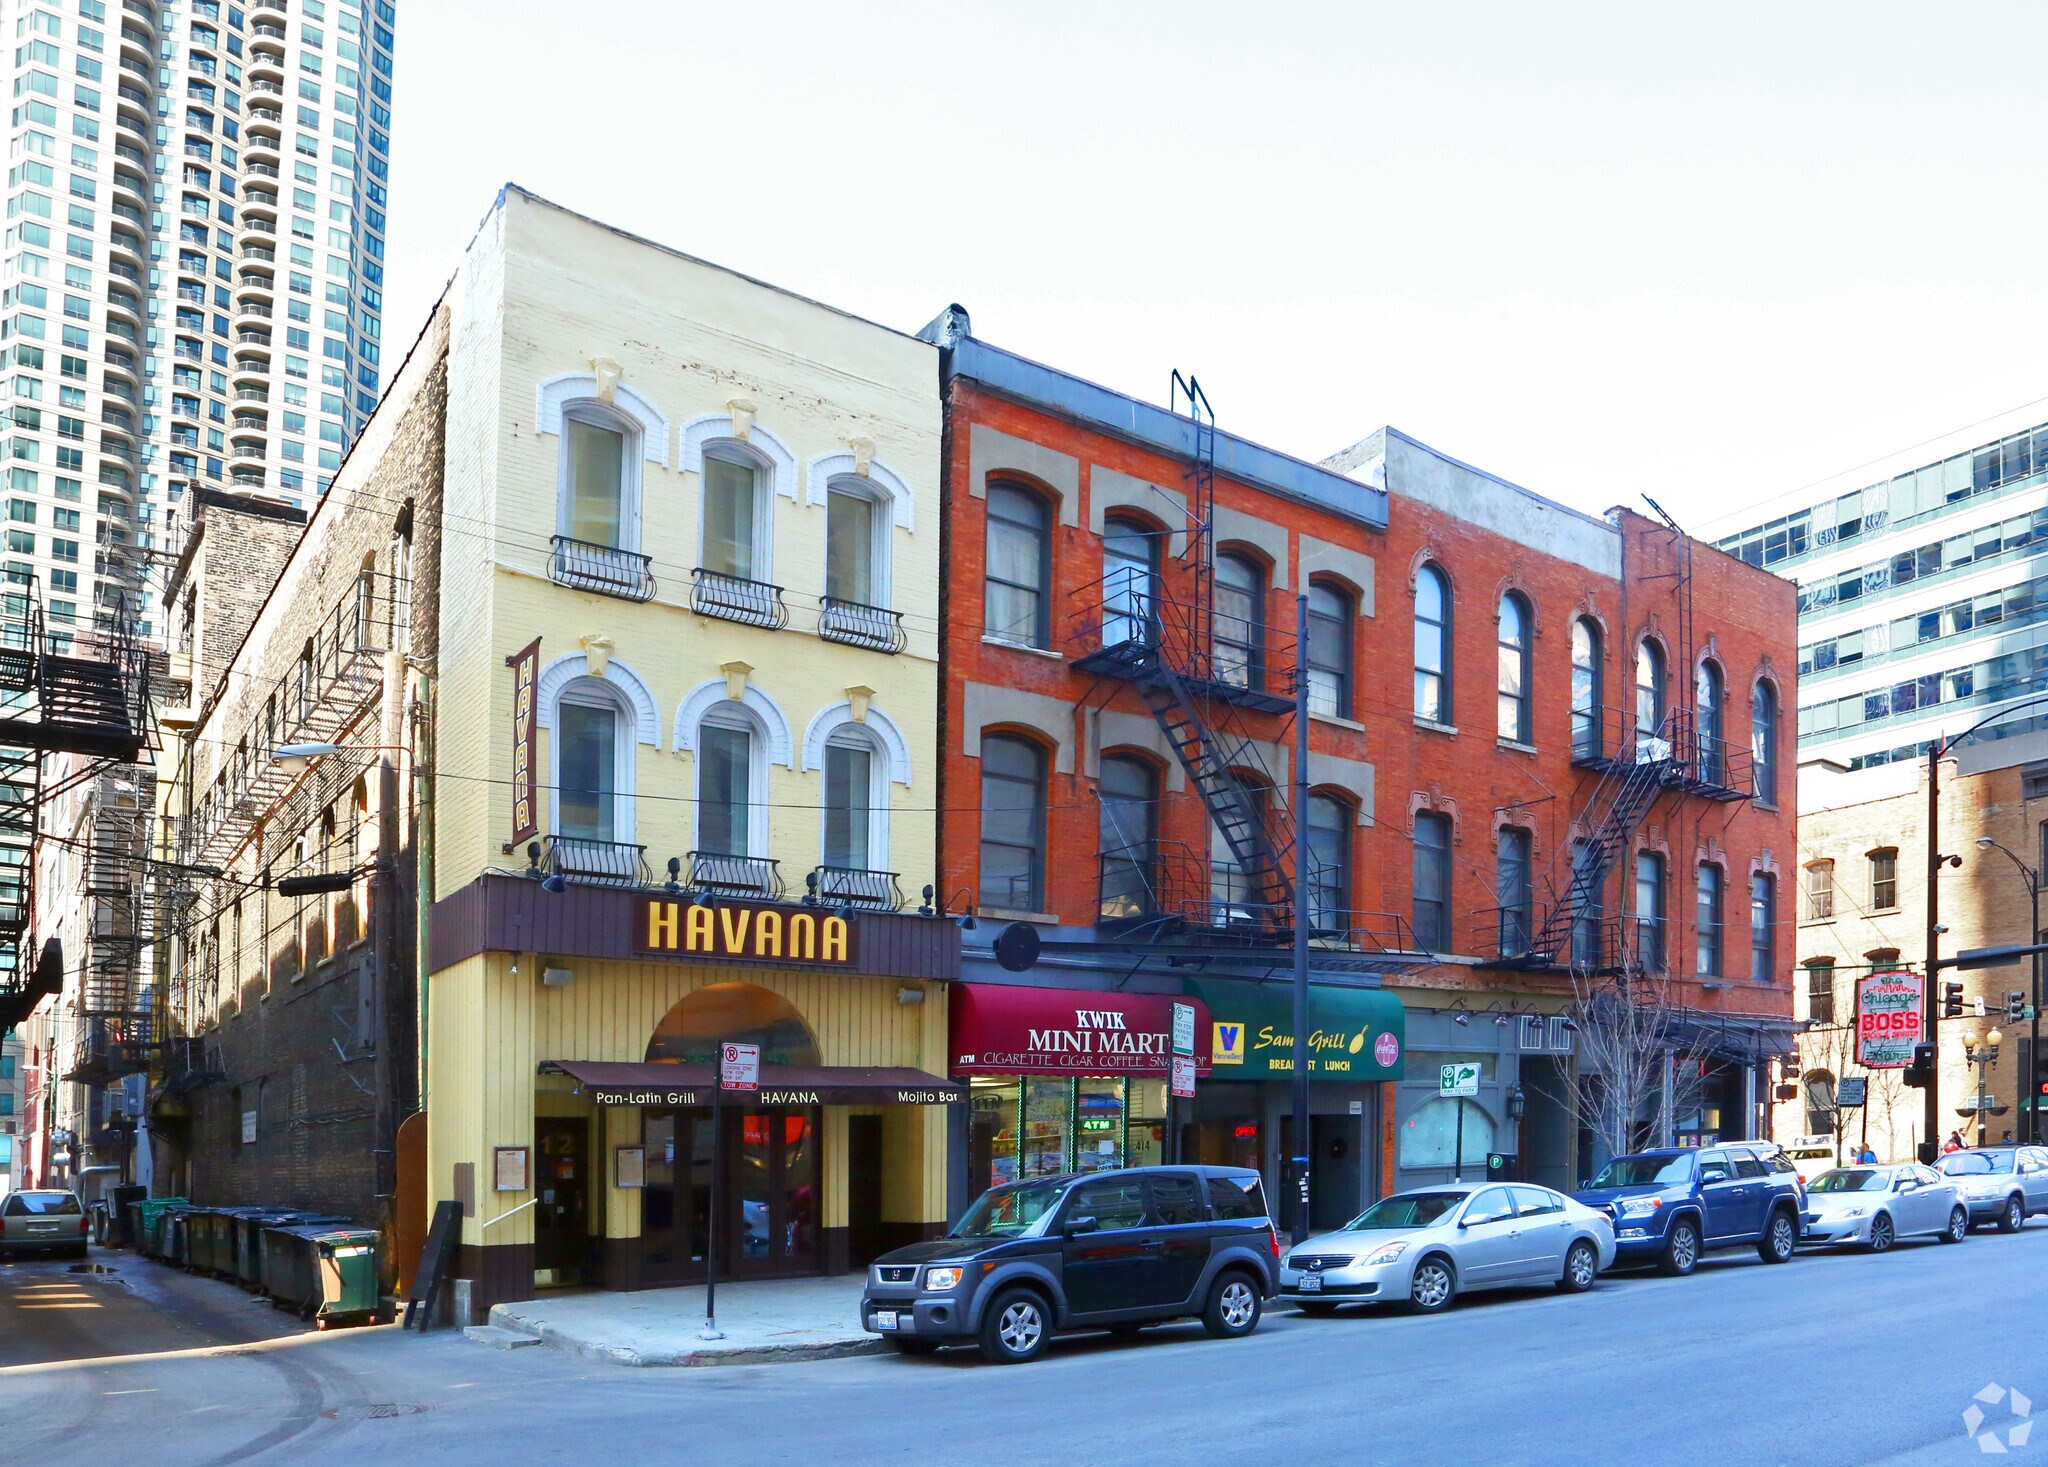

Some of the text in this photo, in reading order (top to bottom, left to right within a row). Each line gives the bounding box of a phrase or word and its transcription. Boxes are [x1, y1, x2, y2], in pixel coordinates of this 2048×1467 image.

[515, 654, 534, 832] HAVANA
[649, 901, 848, 961] HAVANA
[1862, 992, 1920, 1007] Chicago
[1075, 1010, 1127, 1030] KWIK
[1862, 1012, 1919, 1031] BOSS
[1027, 1029, 1169, 1055] MINI MART
[1308, 1029, 1346, 1053] Grill
[959, 1054, 976, 1064] ATM
[983, 1052, 1052, 1067] CIGARETTE
[1059, 1054, 1093, 1067] CIGAR
[1099, 1056, 1144, 1067] COFFEE
[1269, 1059, 1351, 1071] BREAST LUNCH
[596, 1092, 695, 1104] Pan-Latin Grill
[761, 1092, 819, 1104] HAVANA
[898, 1091, 958, 1104] Mojito Bar
[1083, 1120, 1110, 1130] ATM
[1233, 1126, 1257, 1137] OPEN
